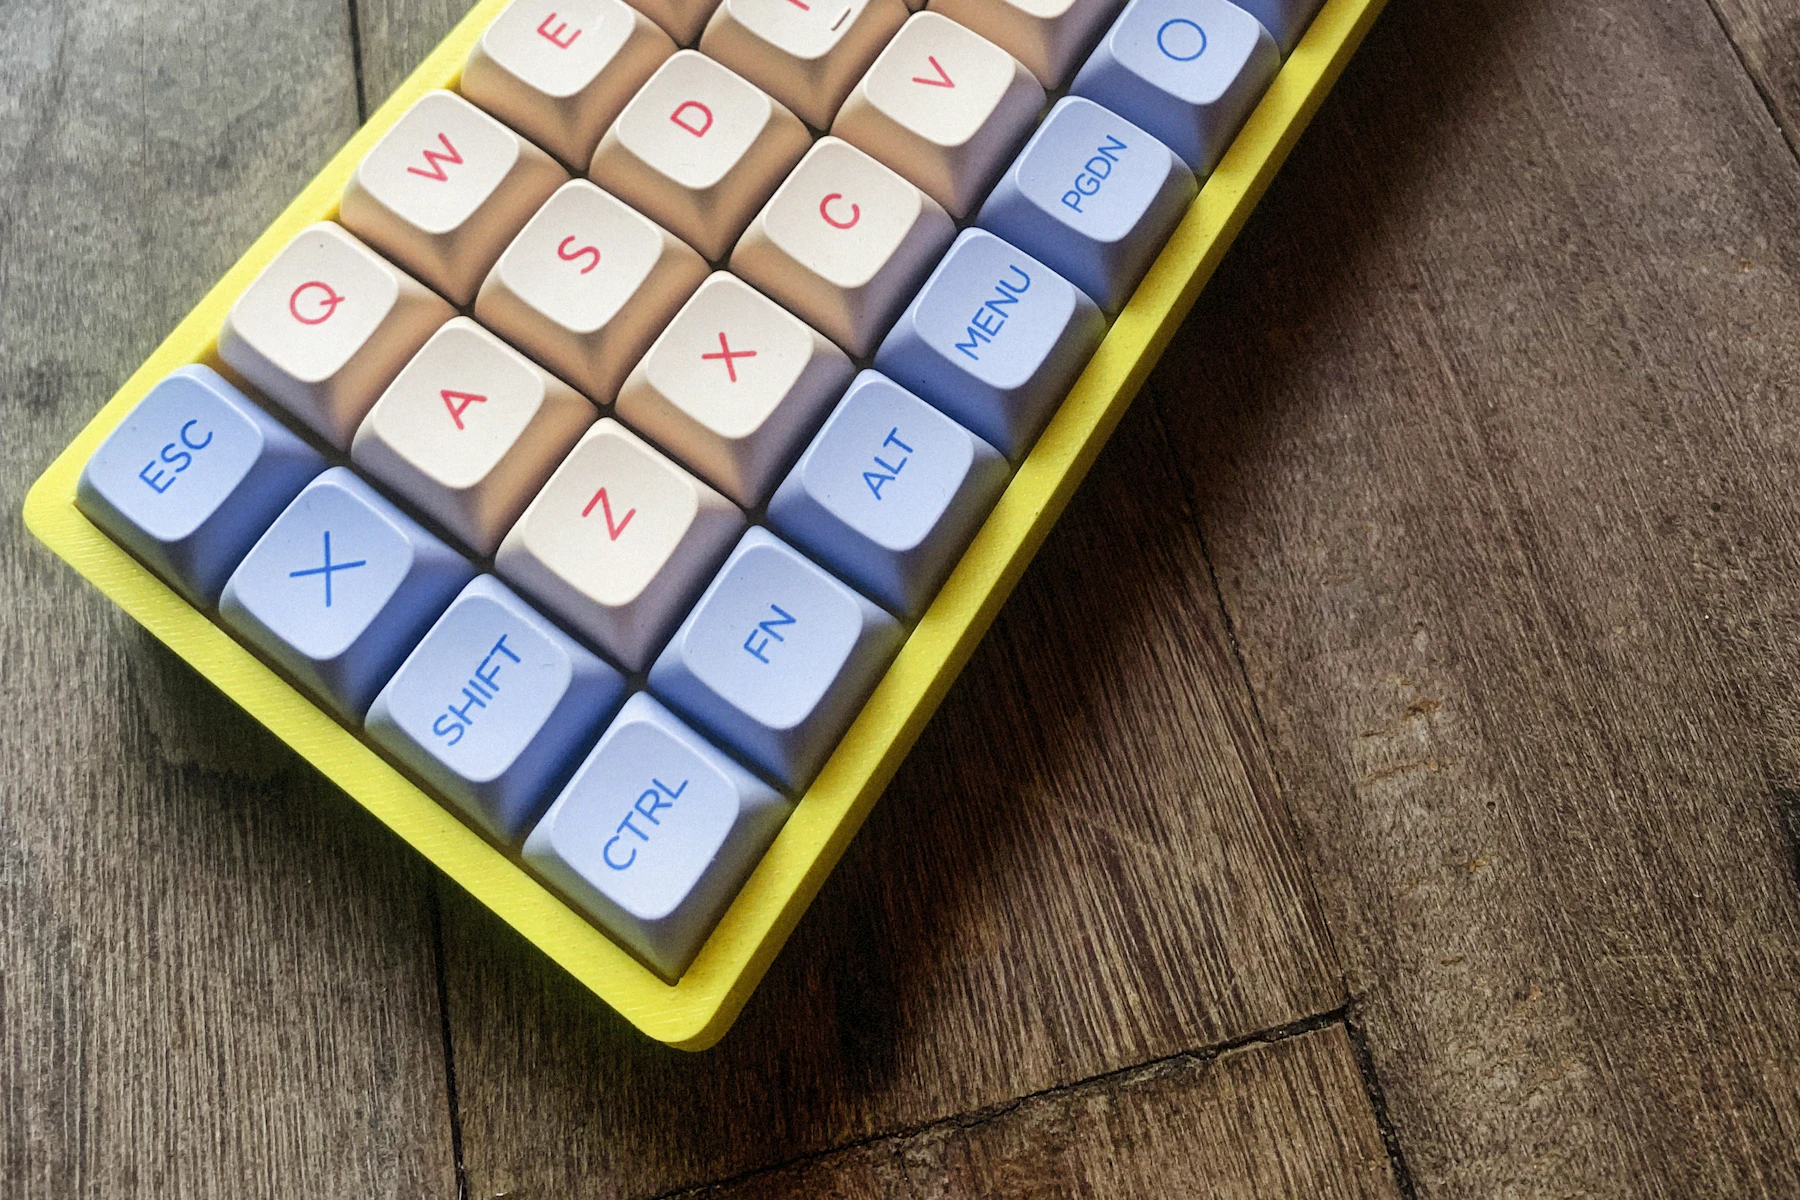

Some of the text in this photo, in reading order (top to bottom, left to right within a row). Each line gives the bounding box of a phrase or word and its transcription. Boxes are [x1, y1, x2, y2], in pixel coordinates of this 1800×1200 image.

[537, 13, 581, 49] E
[912, 56, 954, 88] V
[670, 101, 713, 137] D
[408, 133, 463, 181] W
[1061, 135, 1127, 212] PGDN
[820, 193, 860, 229] C
[557, 236, 600, 274] S
[289, 281, 344, 325] Q
[955, 265, 1030, 360] MENU
[702, 332, 756, 382] X
[441, 390, 487, 429] A
[139, 419, 213, 494] ESC
[863, 427, 913, 500] ALT
[582, 488, 635, 540] Z
[744, 604, 796, 664] FN
[432, 633, 520, 745] SHIFT
[603, 779, 688, 870] CTRL
